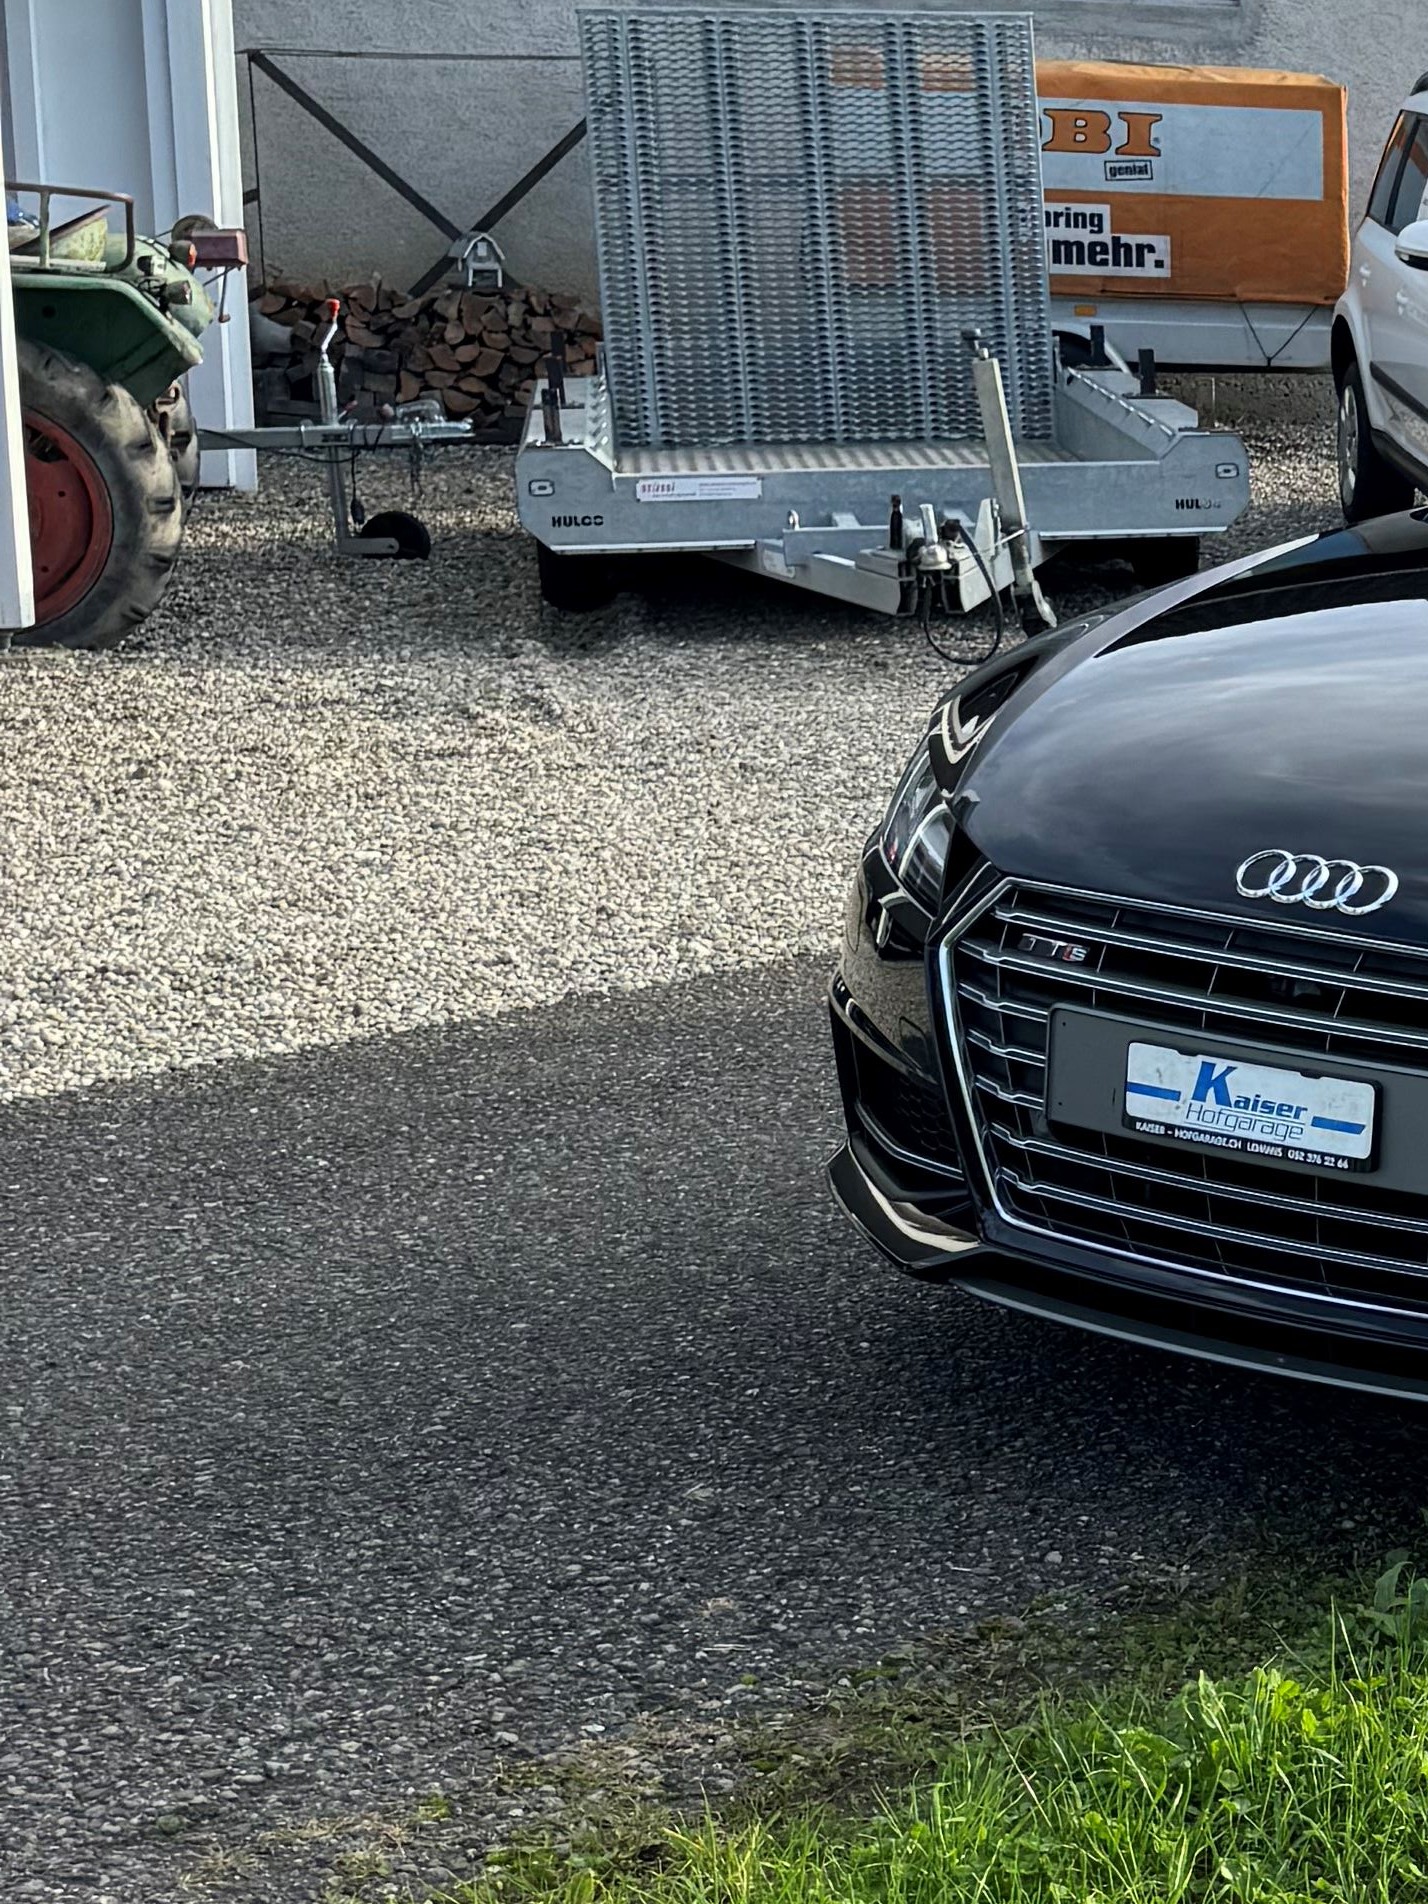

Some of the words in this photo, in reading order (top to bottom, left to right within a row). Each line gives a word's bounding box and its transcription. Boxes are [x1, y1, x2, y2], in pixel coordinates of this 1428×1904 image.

[1040, 108, 1163, 157] BI
[1109, 163, 1149, 178] genial
[1052, 235, 1165, 269] mehr.
[552, 515, 604, 528] HULCO
[1020, 932, 1090, 962] TTS
[1191, 1060, 1308, 1120] Kaiser
[1185, 1102, 1304, 1142] Hofgarage
